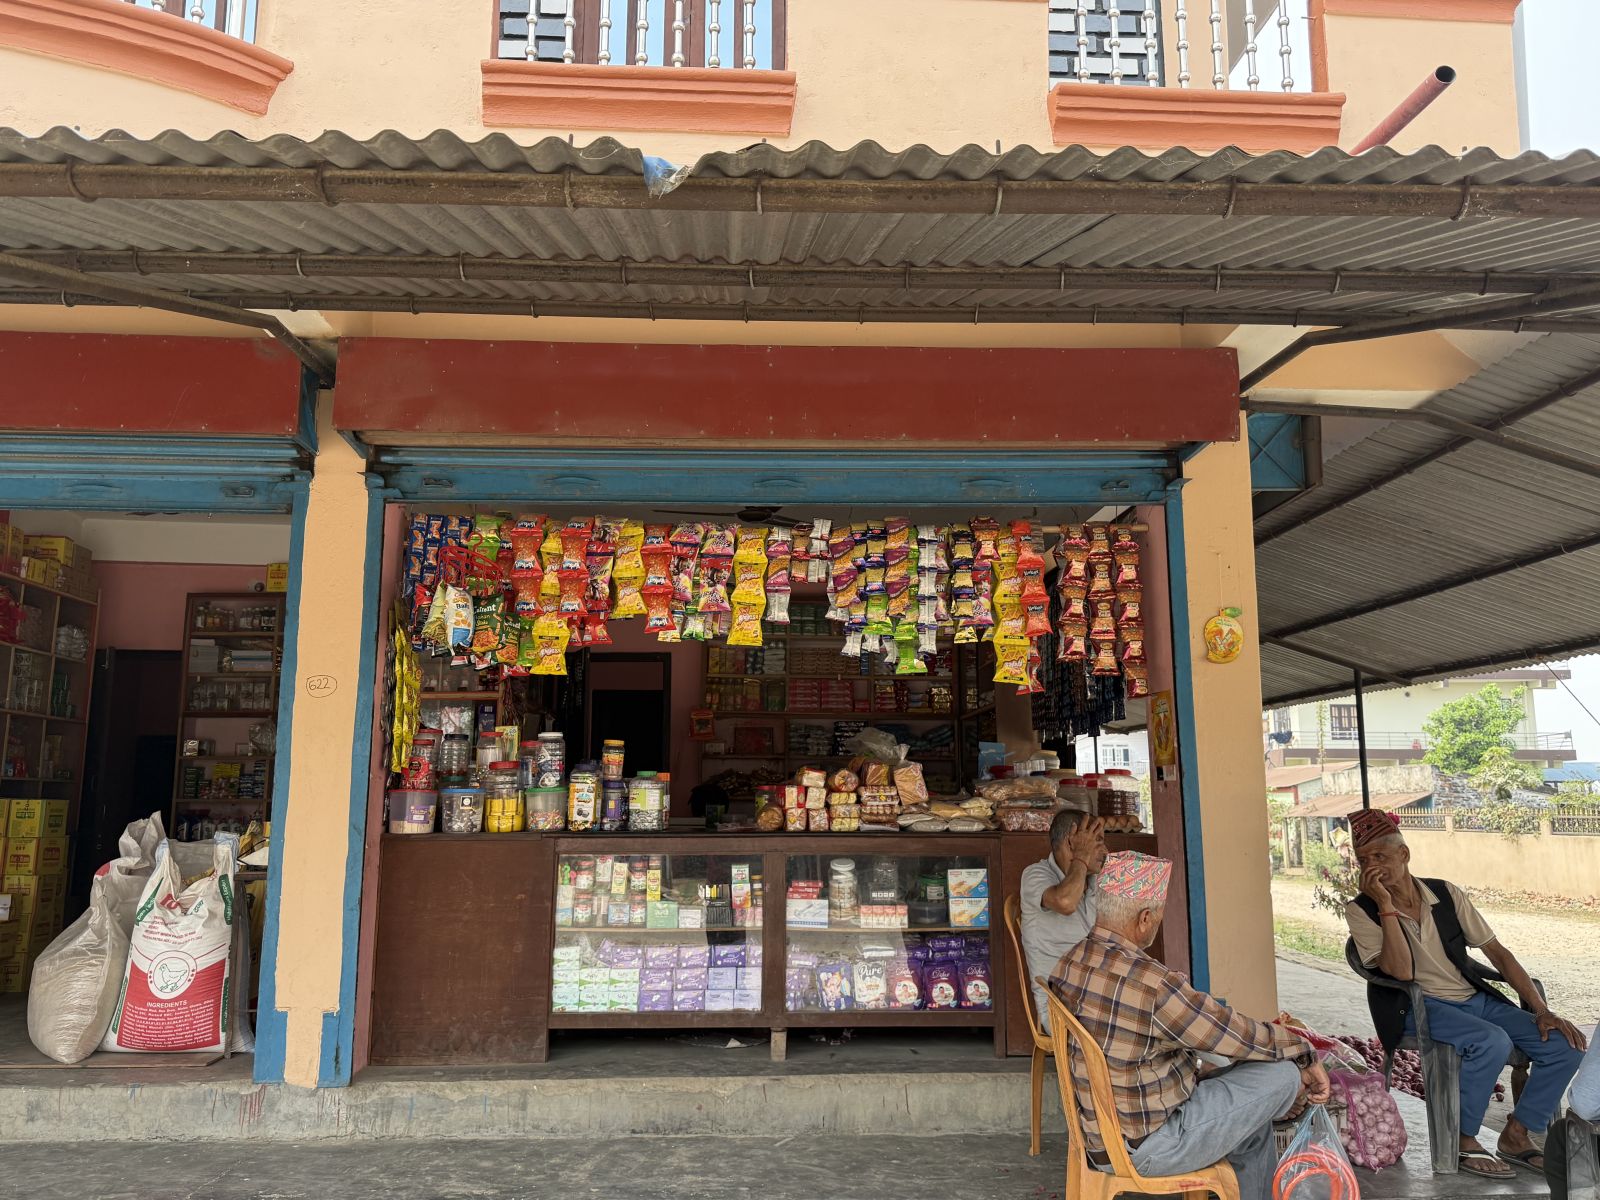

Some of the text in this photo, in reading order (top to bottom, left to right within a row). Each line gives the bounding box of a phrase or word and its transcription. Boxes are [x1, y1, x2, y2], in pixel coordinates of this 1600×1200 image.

[308, 677, 331, 691] 622
[858, 964, 882, 978] Pure
[146, 1000, 188, 1008] INGREDIENTS
